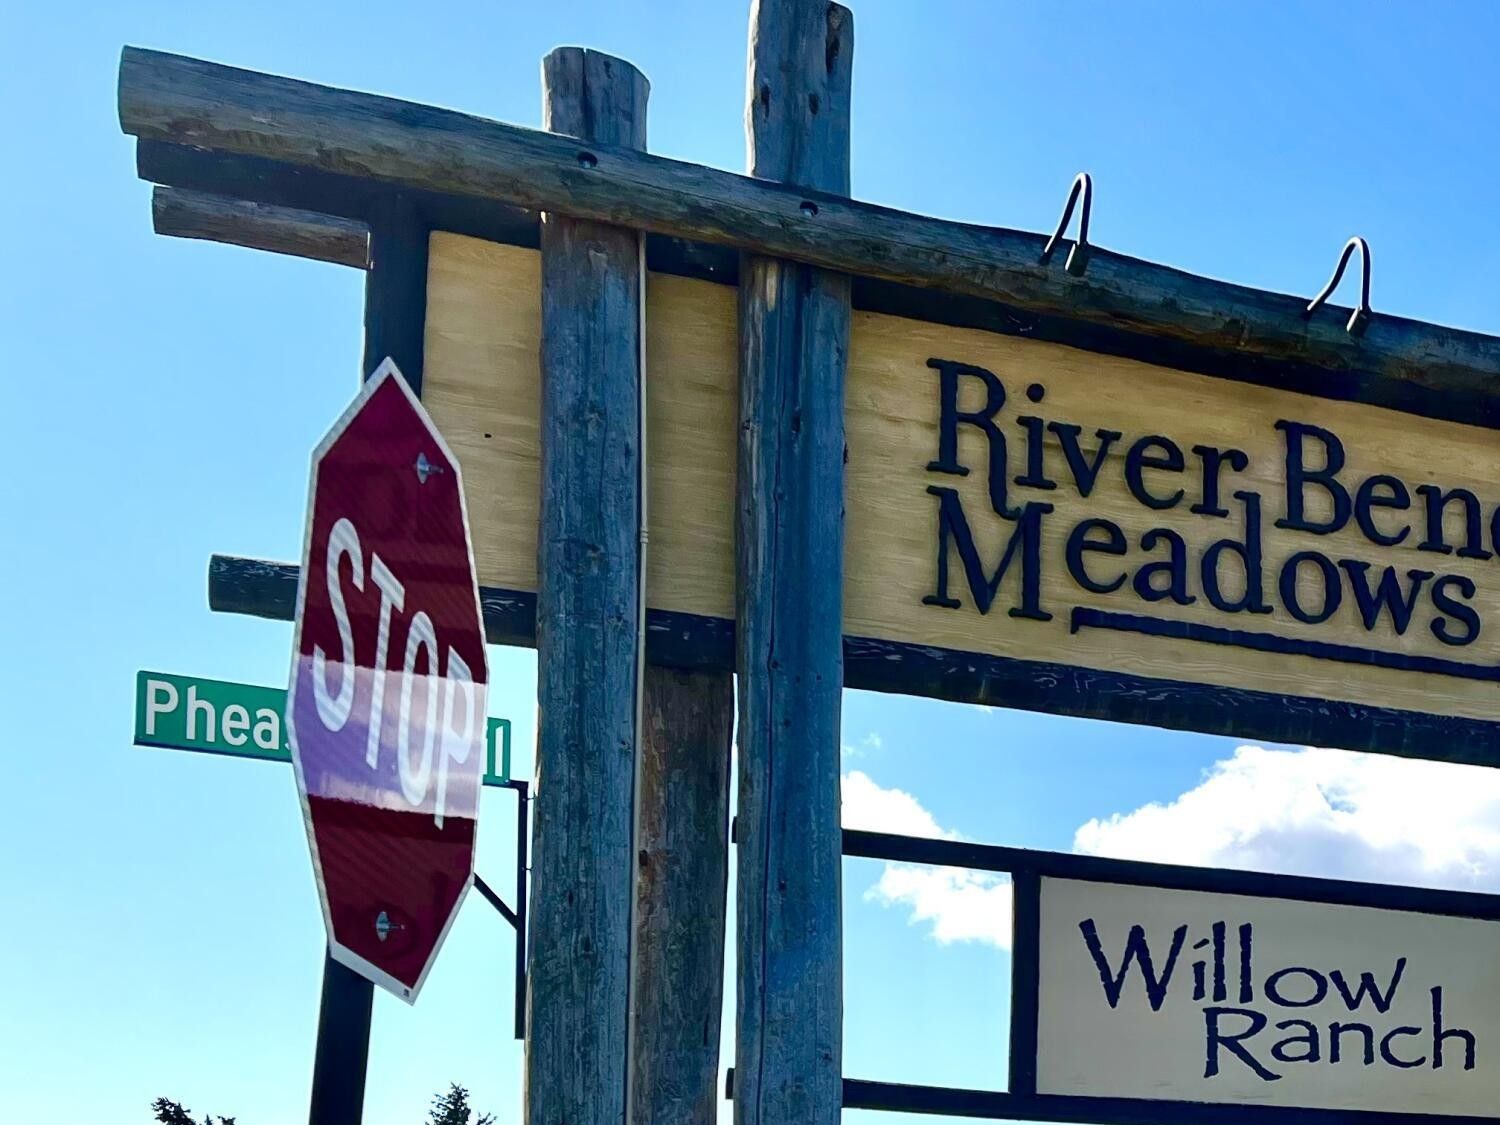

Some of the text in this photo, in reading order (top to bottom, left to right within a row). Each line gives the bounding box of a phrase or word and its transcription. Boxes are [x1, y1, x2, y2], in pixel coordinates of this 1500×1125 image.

[926, 357, 1249, 520] River
[921, 485, 1482, 647] Meadows
[145, 679, 290, 751] Phea
[313, 517, 475, 831] STOP
[1078, 917, 1407, 1014] Willow
[1203, 985, 1476, 1082] Ranch
